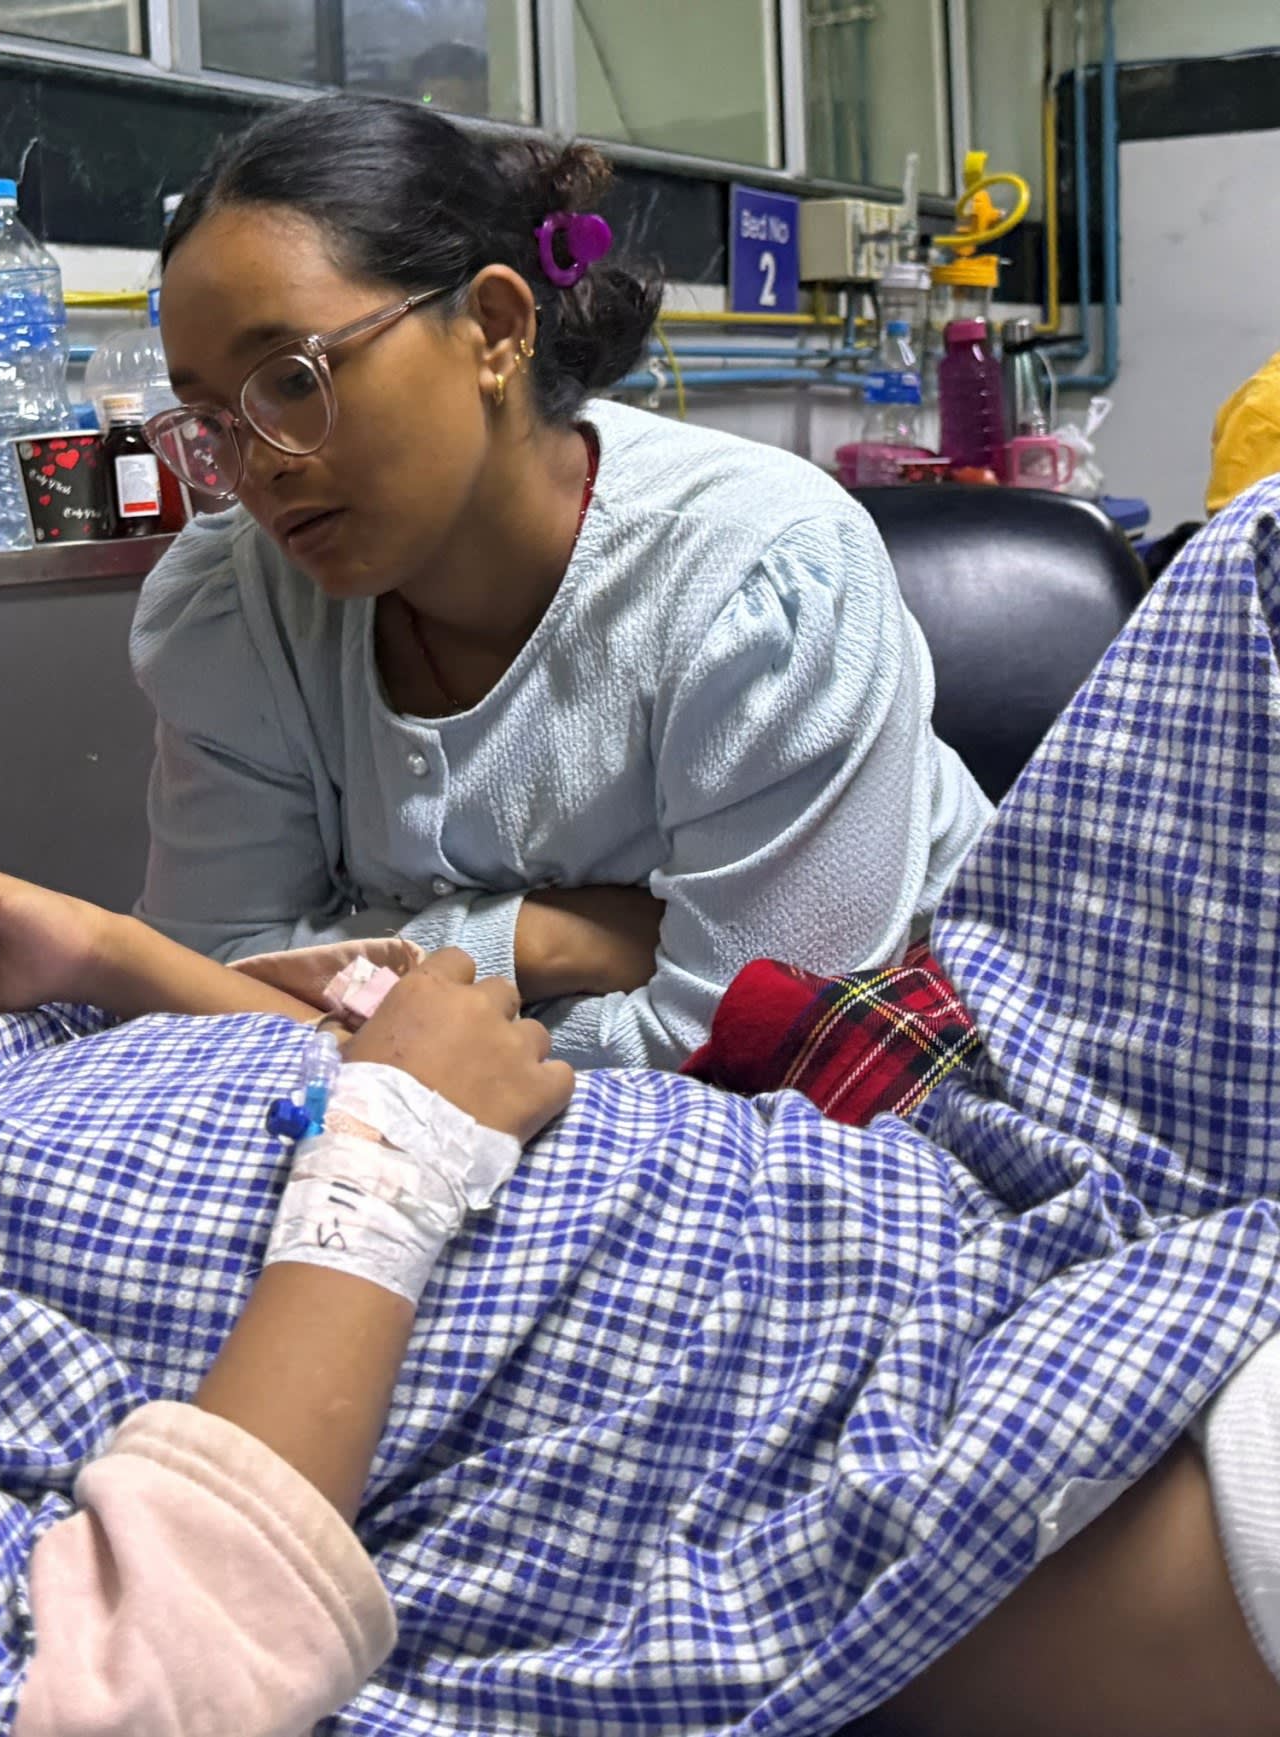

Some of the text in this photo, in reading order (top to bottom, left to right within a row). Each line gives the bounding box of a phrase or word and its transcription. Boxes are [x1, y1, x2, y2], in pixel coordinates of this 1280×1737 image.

[741, 208, 790, 245] Bed No
[759, 251, 776, 306] 2
